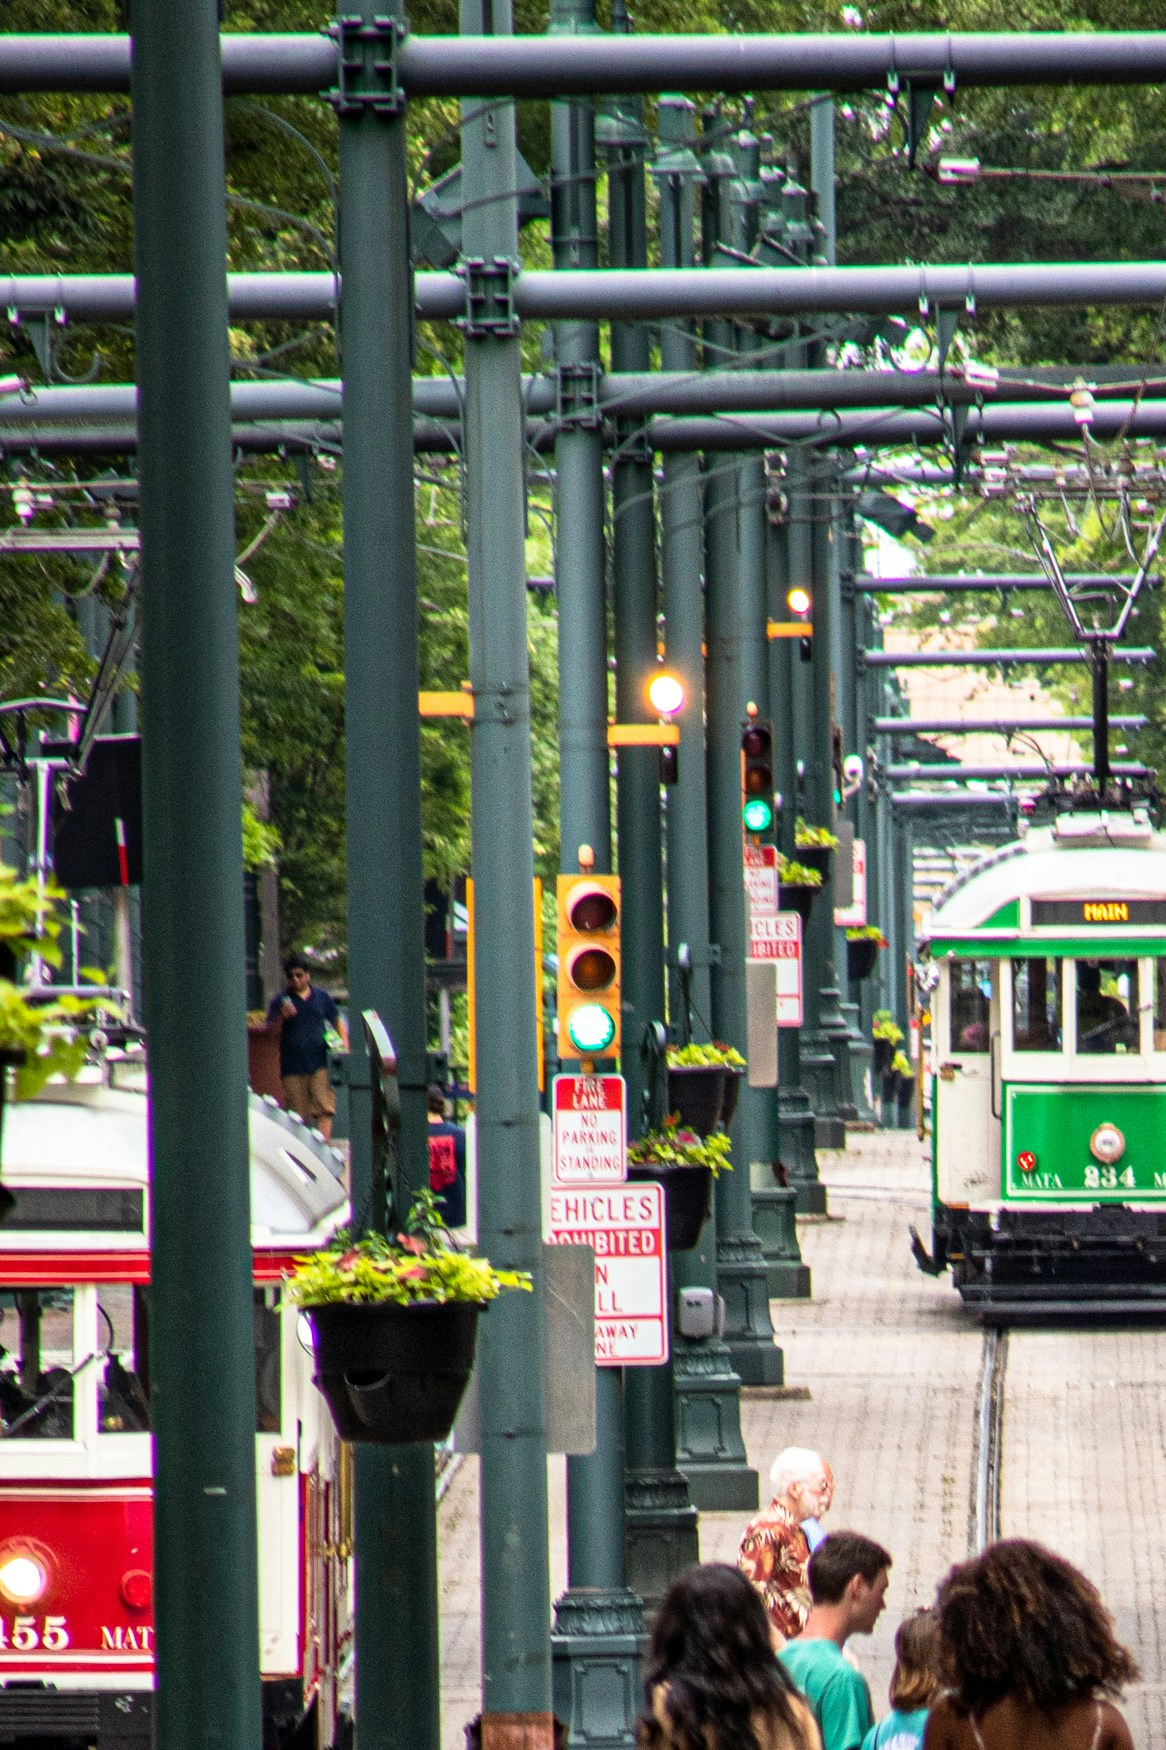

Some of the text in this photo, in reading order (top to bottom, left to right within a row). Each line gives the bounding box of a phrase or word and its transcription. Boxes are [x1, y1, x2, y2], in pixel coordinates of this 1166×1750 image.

[1084, 903, 1128, 921] MAIN
[574, 1078, 605, 1094] FIRE
[572, 1092, 607, 1110] LANE
[581, 1113, 598, 1128] NO
[562, 1130, 617, 1145] PARKING
[560, 1155, 620, 1171] STANDING
[1022, 1171, 1063, 1188] MATA
[1084, 1165, 1136, 1188] 234
[551, 1197, 653, 1221] EHICLES
[595, 1264, 608, 1286] N
[598, 1290, 624, 1313] LL
[595, 1325, 638, 1340] AWAY
[596, 1342, 619, 1357] NE
[0, 1616, 69, 1650] 55
[101, 1626, 154, 1650] MAT
